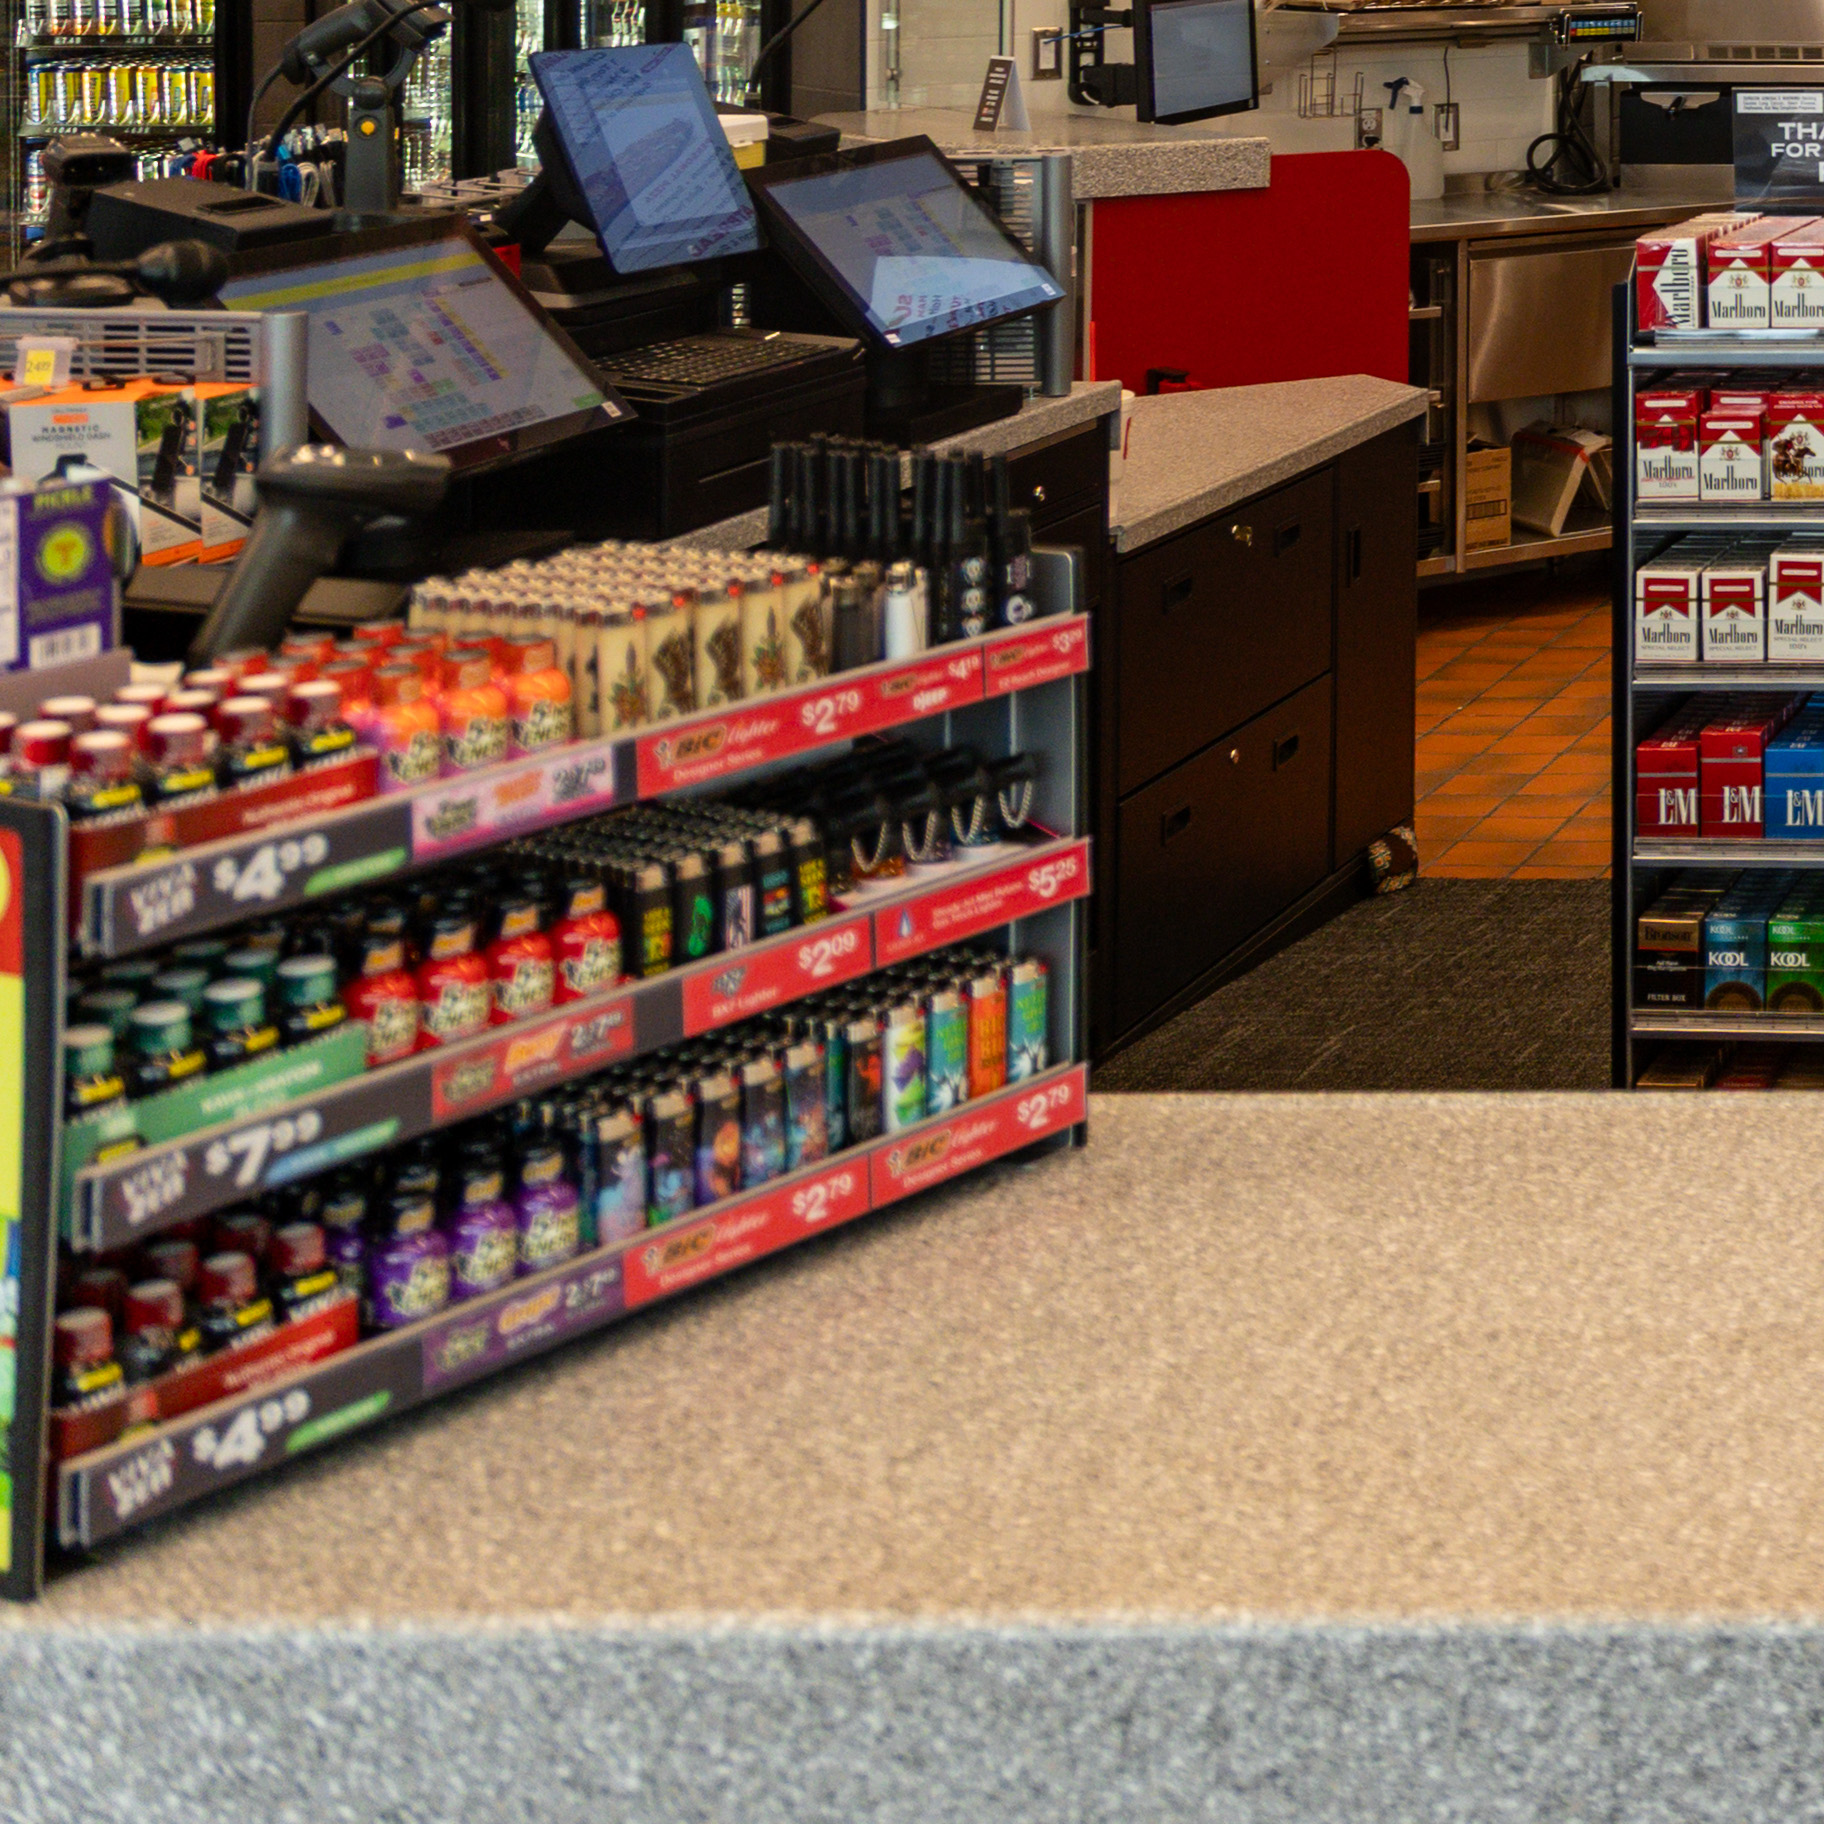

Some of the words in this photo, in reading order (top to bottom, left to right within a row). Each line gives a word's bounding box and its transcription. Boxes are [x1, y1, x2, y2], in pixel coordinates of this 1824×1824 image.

[1771, 143, 1824, 158] FOR
[1711, 294, 1766, 321] Marlboro
[1723, 785, 1761, 823] L&M
[1708, 951, 1748, 967] KOOL
